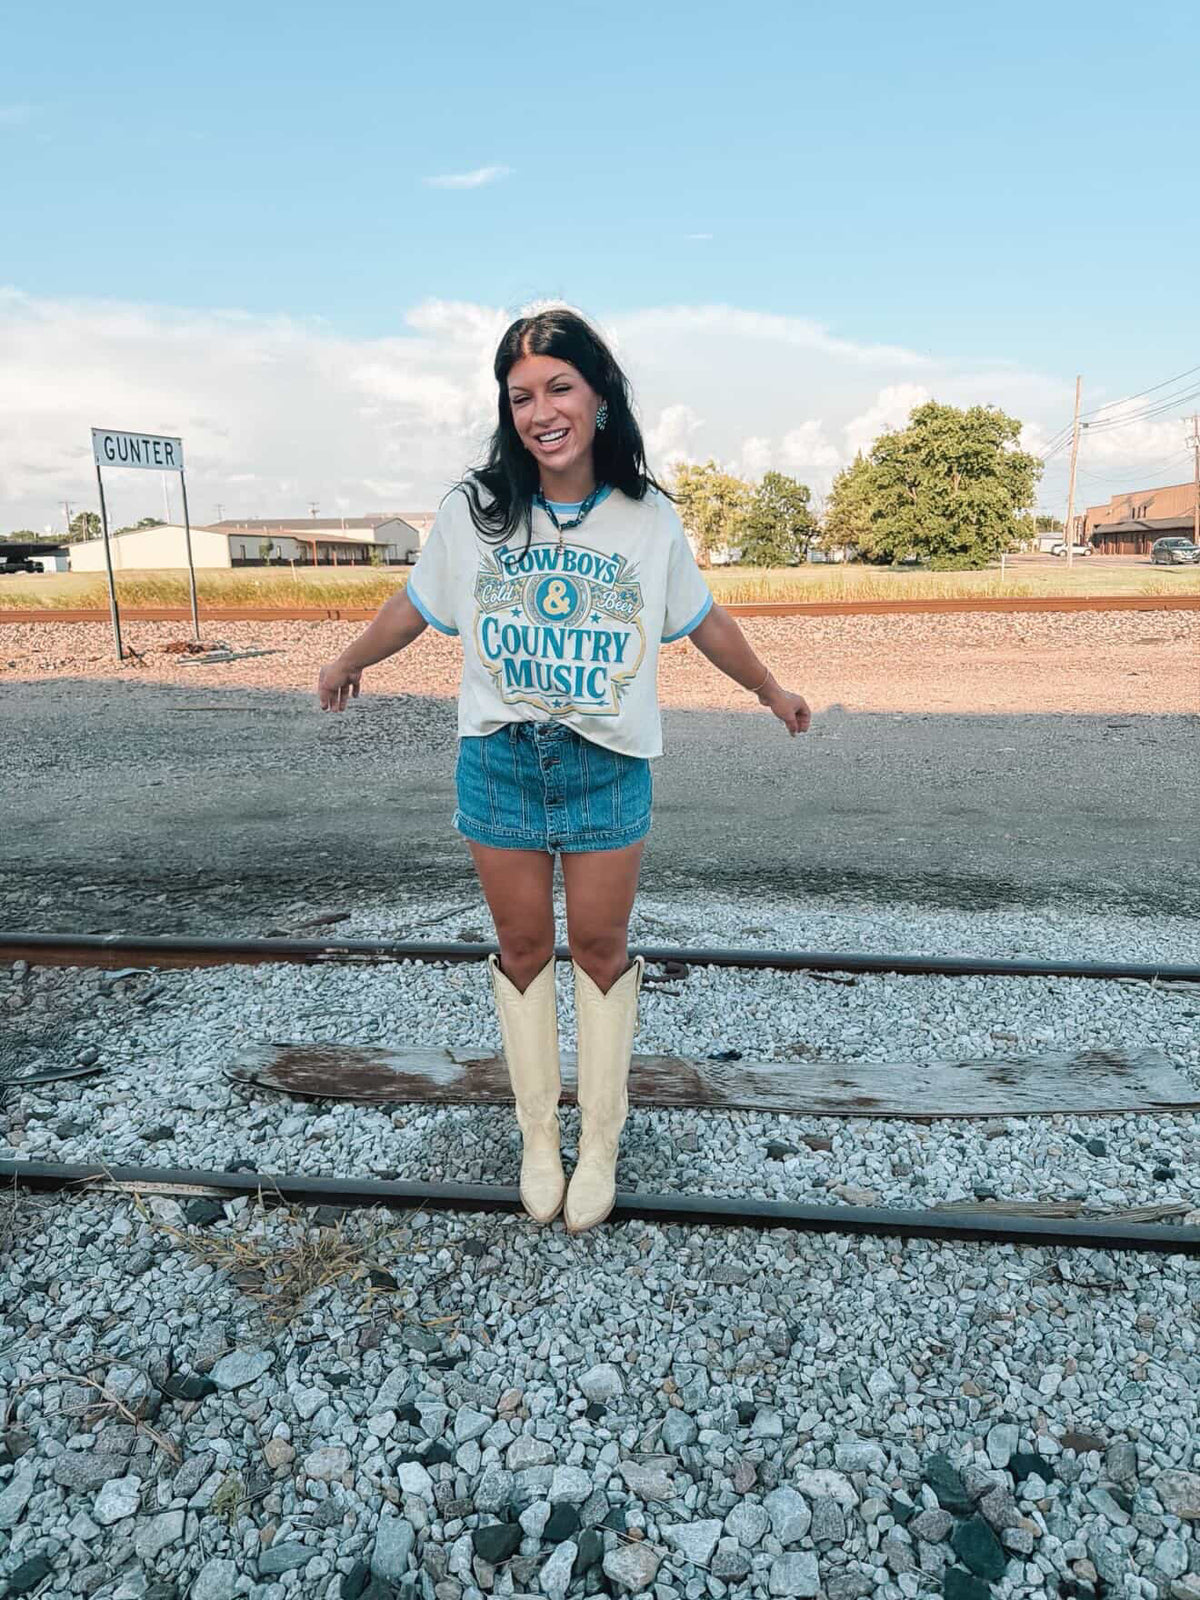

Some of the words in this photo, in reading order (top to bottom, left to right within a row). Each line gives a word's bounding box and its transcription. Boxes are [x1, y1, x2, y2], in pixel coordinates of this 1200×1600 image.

[104, 436, 175, 466] GUNTER
[504, 548, 618, 584] COWBOYS
[482, 584, 514, 604] Cold
[543, 579, 570, 615] &
[597, 591, 634, 613] Beer
[482, 616, 630, 662] COUNTRY
[503, 658, 607, 699] MUSIC
